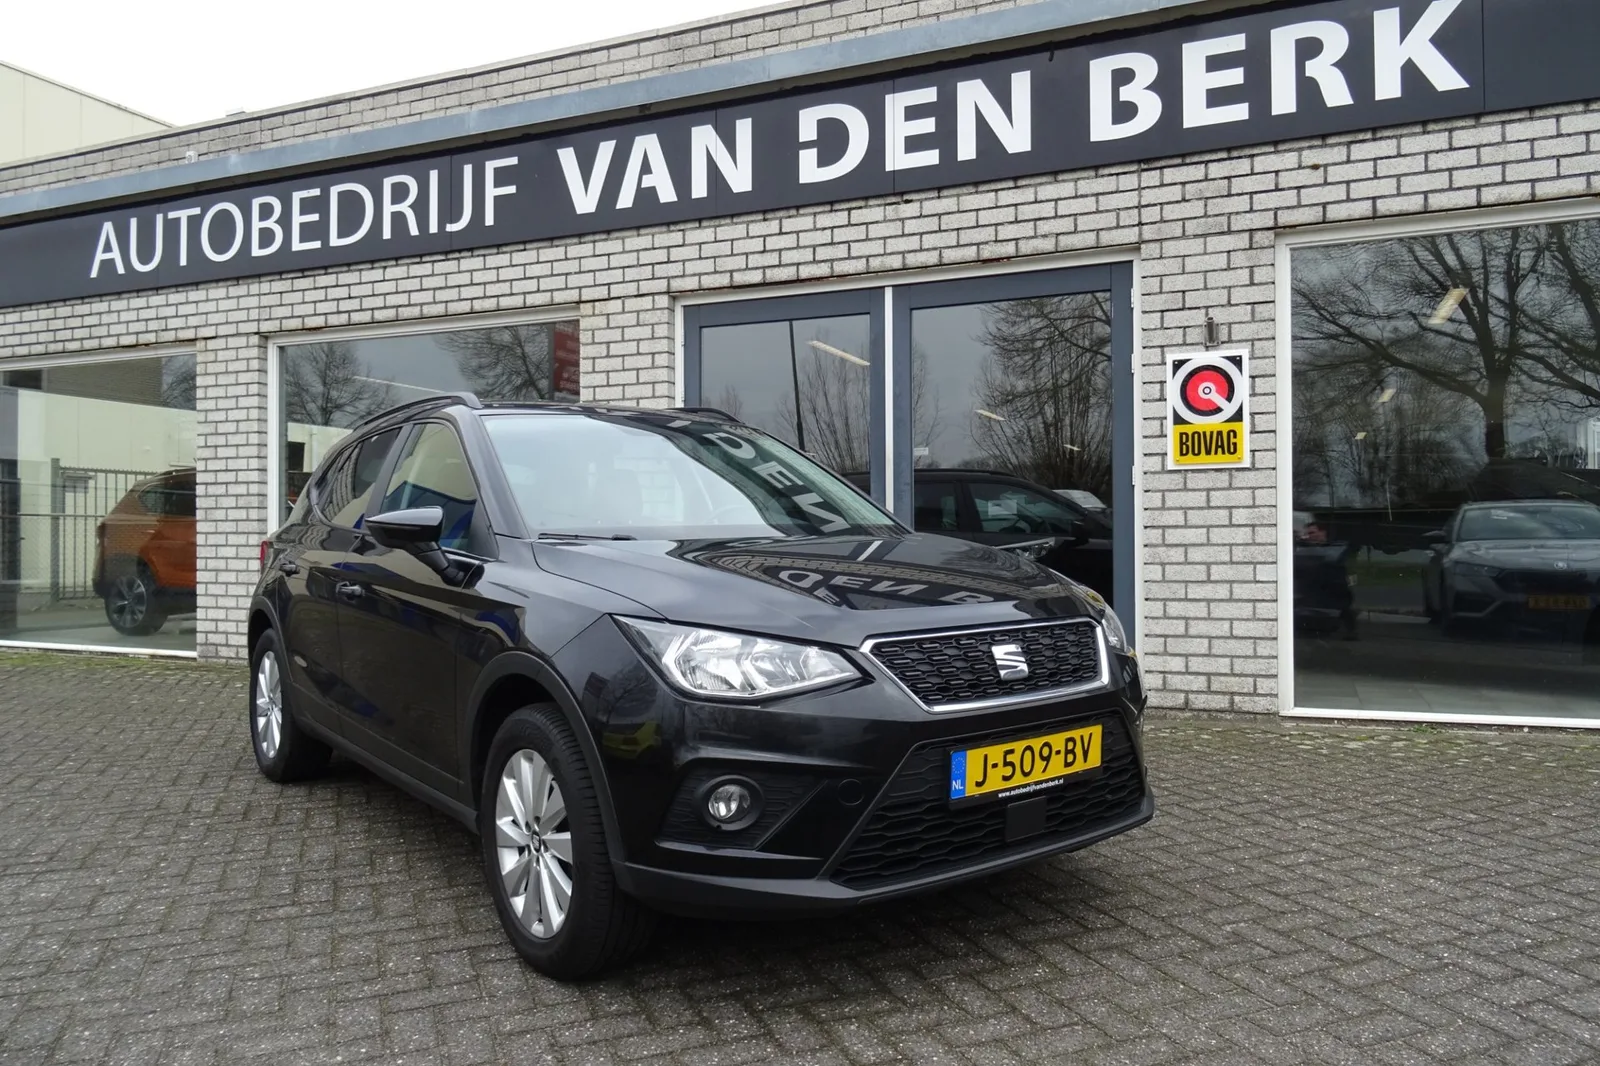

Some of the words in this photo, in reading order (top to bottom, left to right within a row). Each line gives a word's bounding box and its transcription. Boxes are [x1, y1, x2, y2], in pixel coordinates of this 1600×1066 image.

[90, 157, 519, 279] AUTOBEDRIJF
[556, 117, 753, 215] VAN
[798, 70, 1032, 184] DEN
[1089, 0, 1469, 142] BERK
[1178, 429, 1238, 457] BOVAG
[952, 779, 964, 791] NL
[974, 732, 1093, 788] J-509-BV
